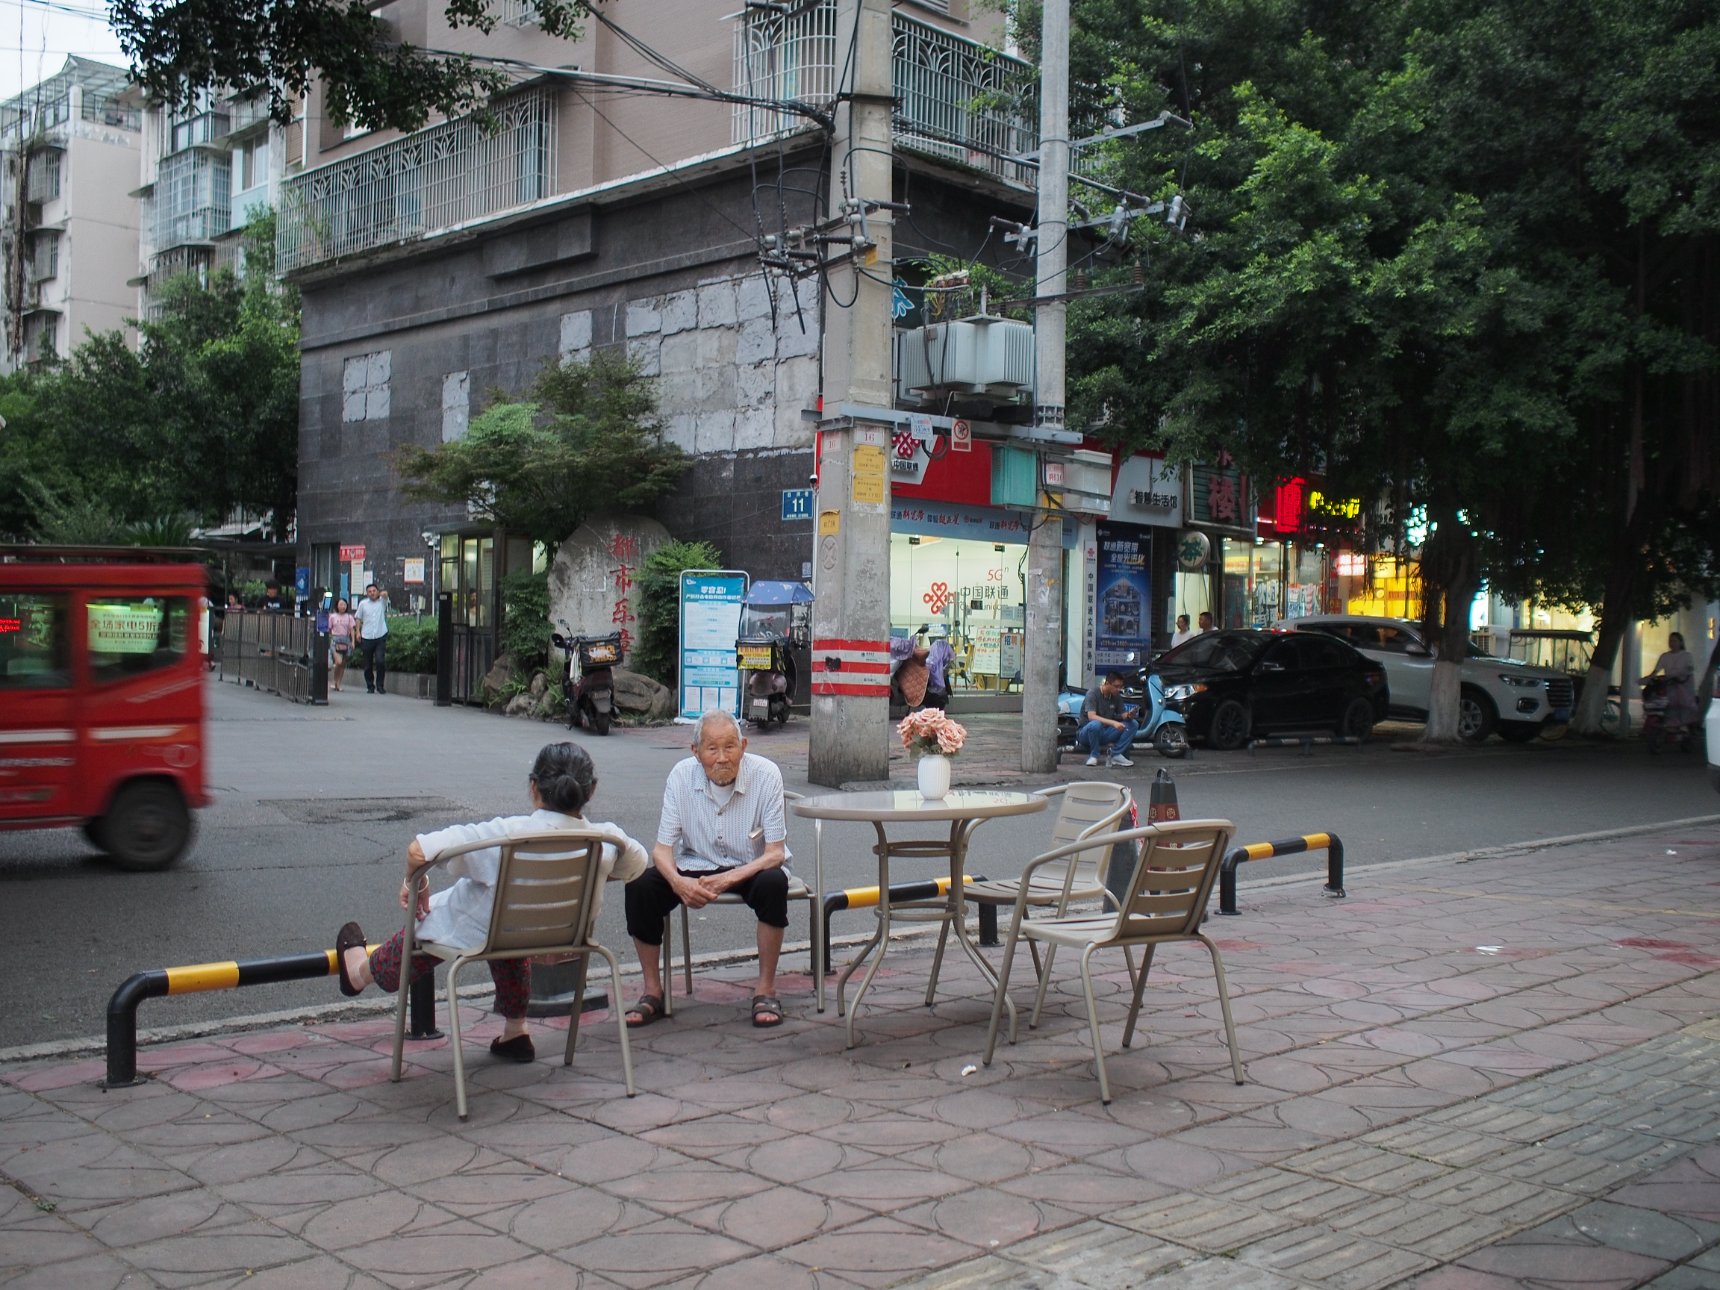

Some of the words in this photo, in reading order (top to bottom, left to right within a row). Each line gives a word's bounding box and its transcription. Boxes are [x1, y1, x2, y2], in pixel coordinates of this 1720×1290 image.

[792, 497, 804, 512] 11
[1135, 490, 1178, 509] 智慧生活馆
[960, 585, 1009, 600] 中国联通
